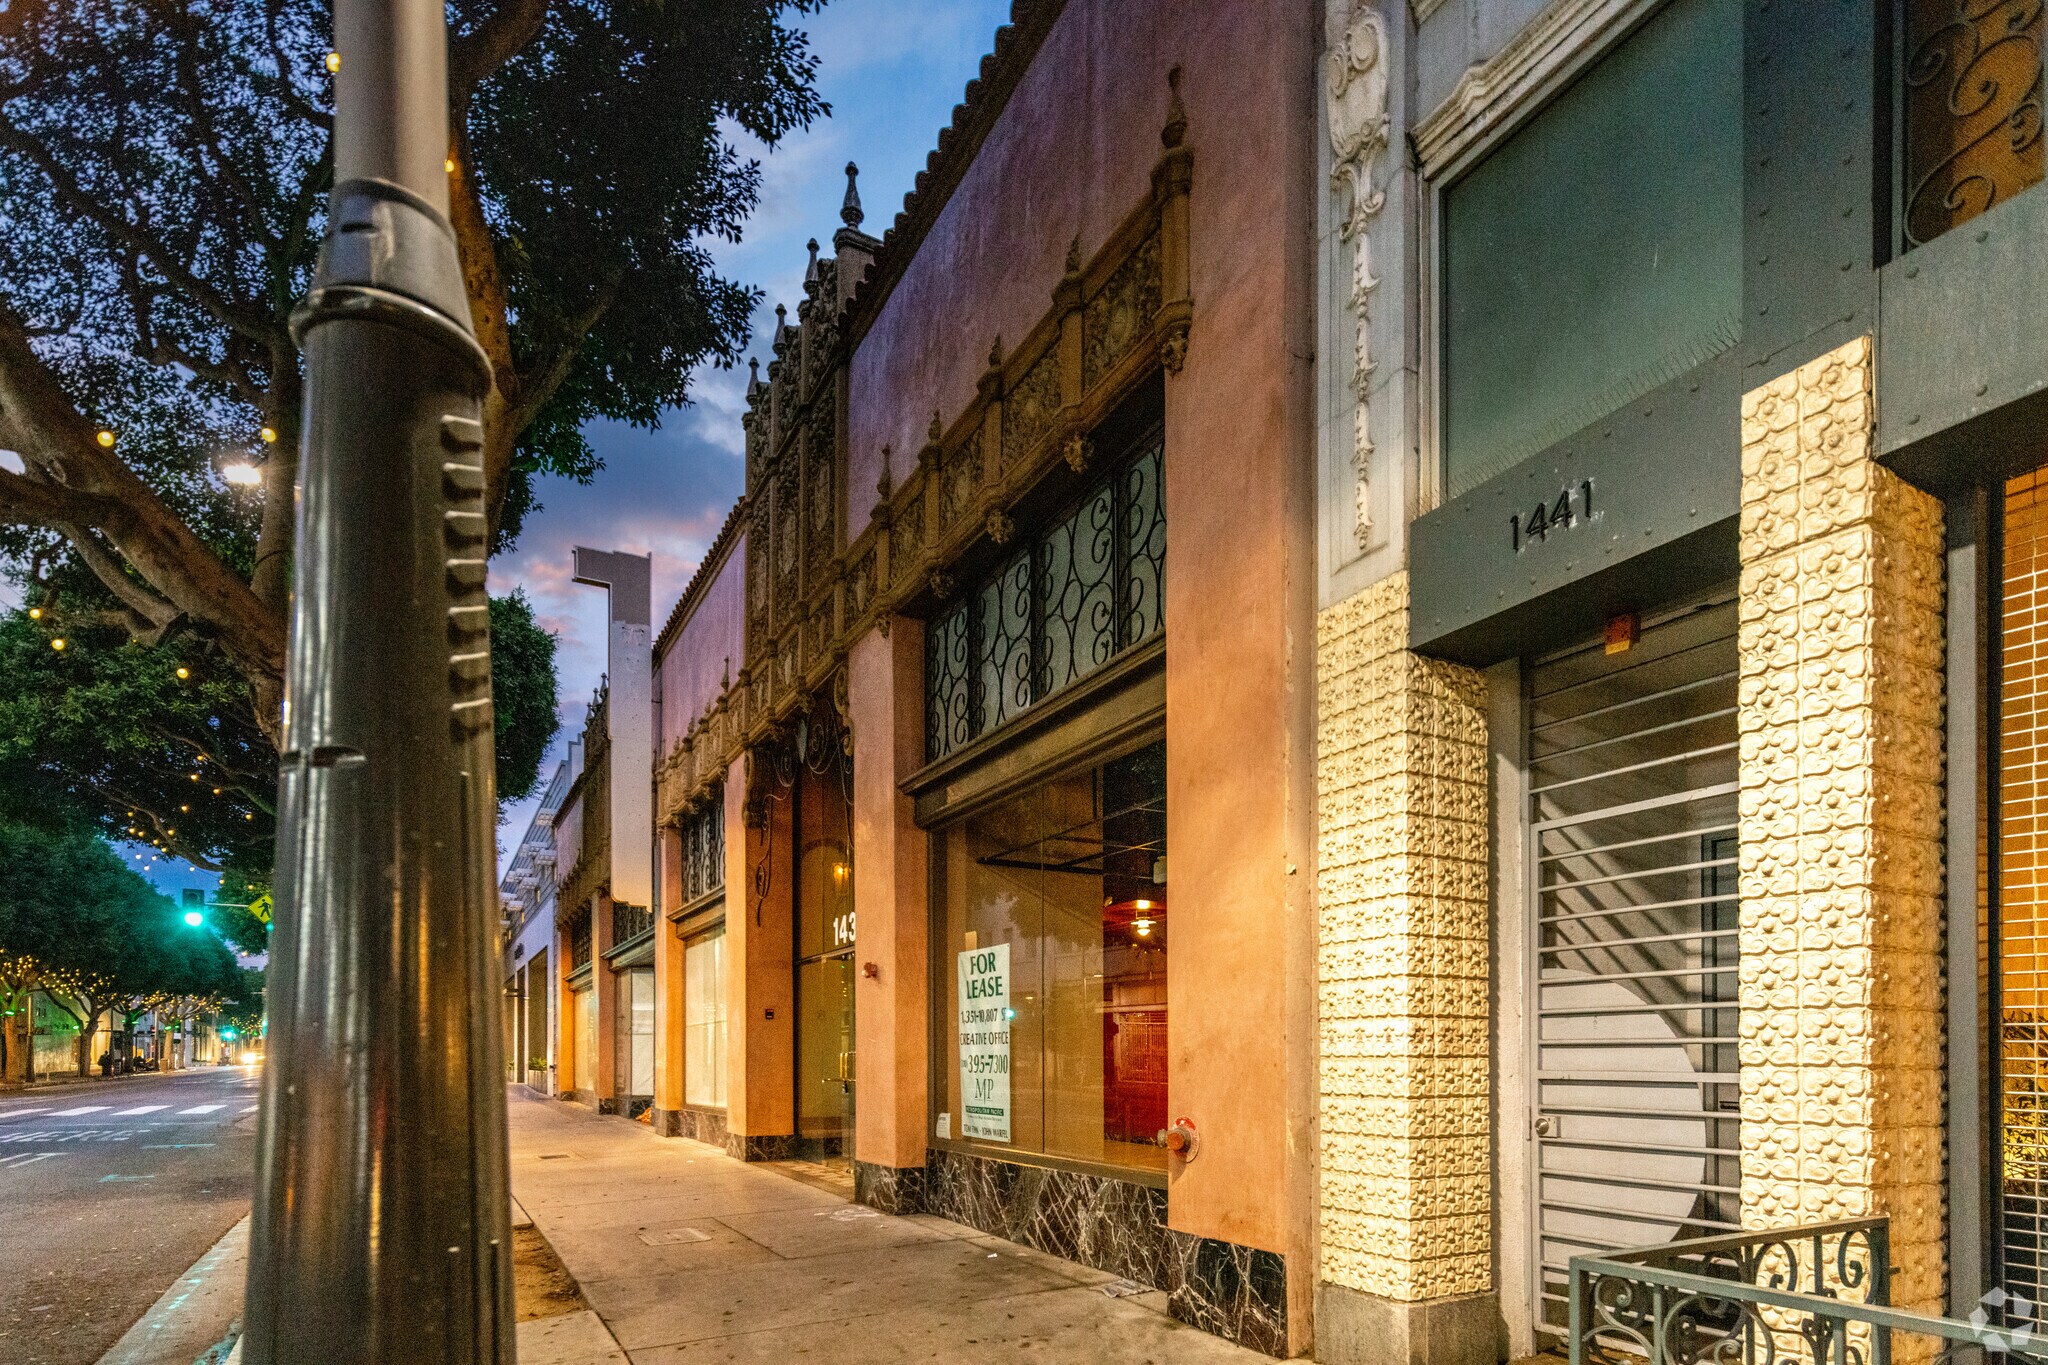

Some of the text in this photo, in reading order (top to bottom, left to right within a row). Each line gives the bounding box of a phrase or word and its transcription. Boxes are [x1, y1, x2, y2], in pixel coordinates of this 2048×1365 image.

[1509, 480, 1592, 554] 1441
[970, 952, 996, 975] FOR
[966, 976, 1003, 999] LEASE
[960, 1031, 1009, 1046] CREATIVE OFFICE
[967, 1054, 1009, 1074] 395-7300
[975, 1078, 994, 1104] MP
